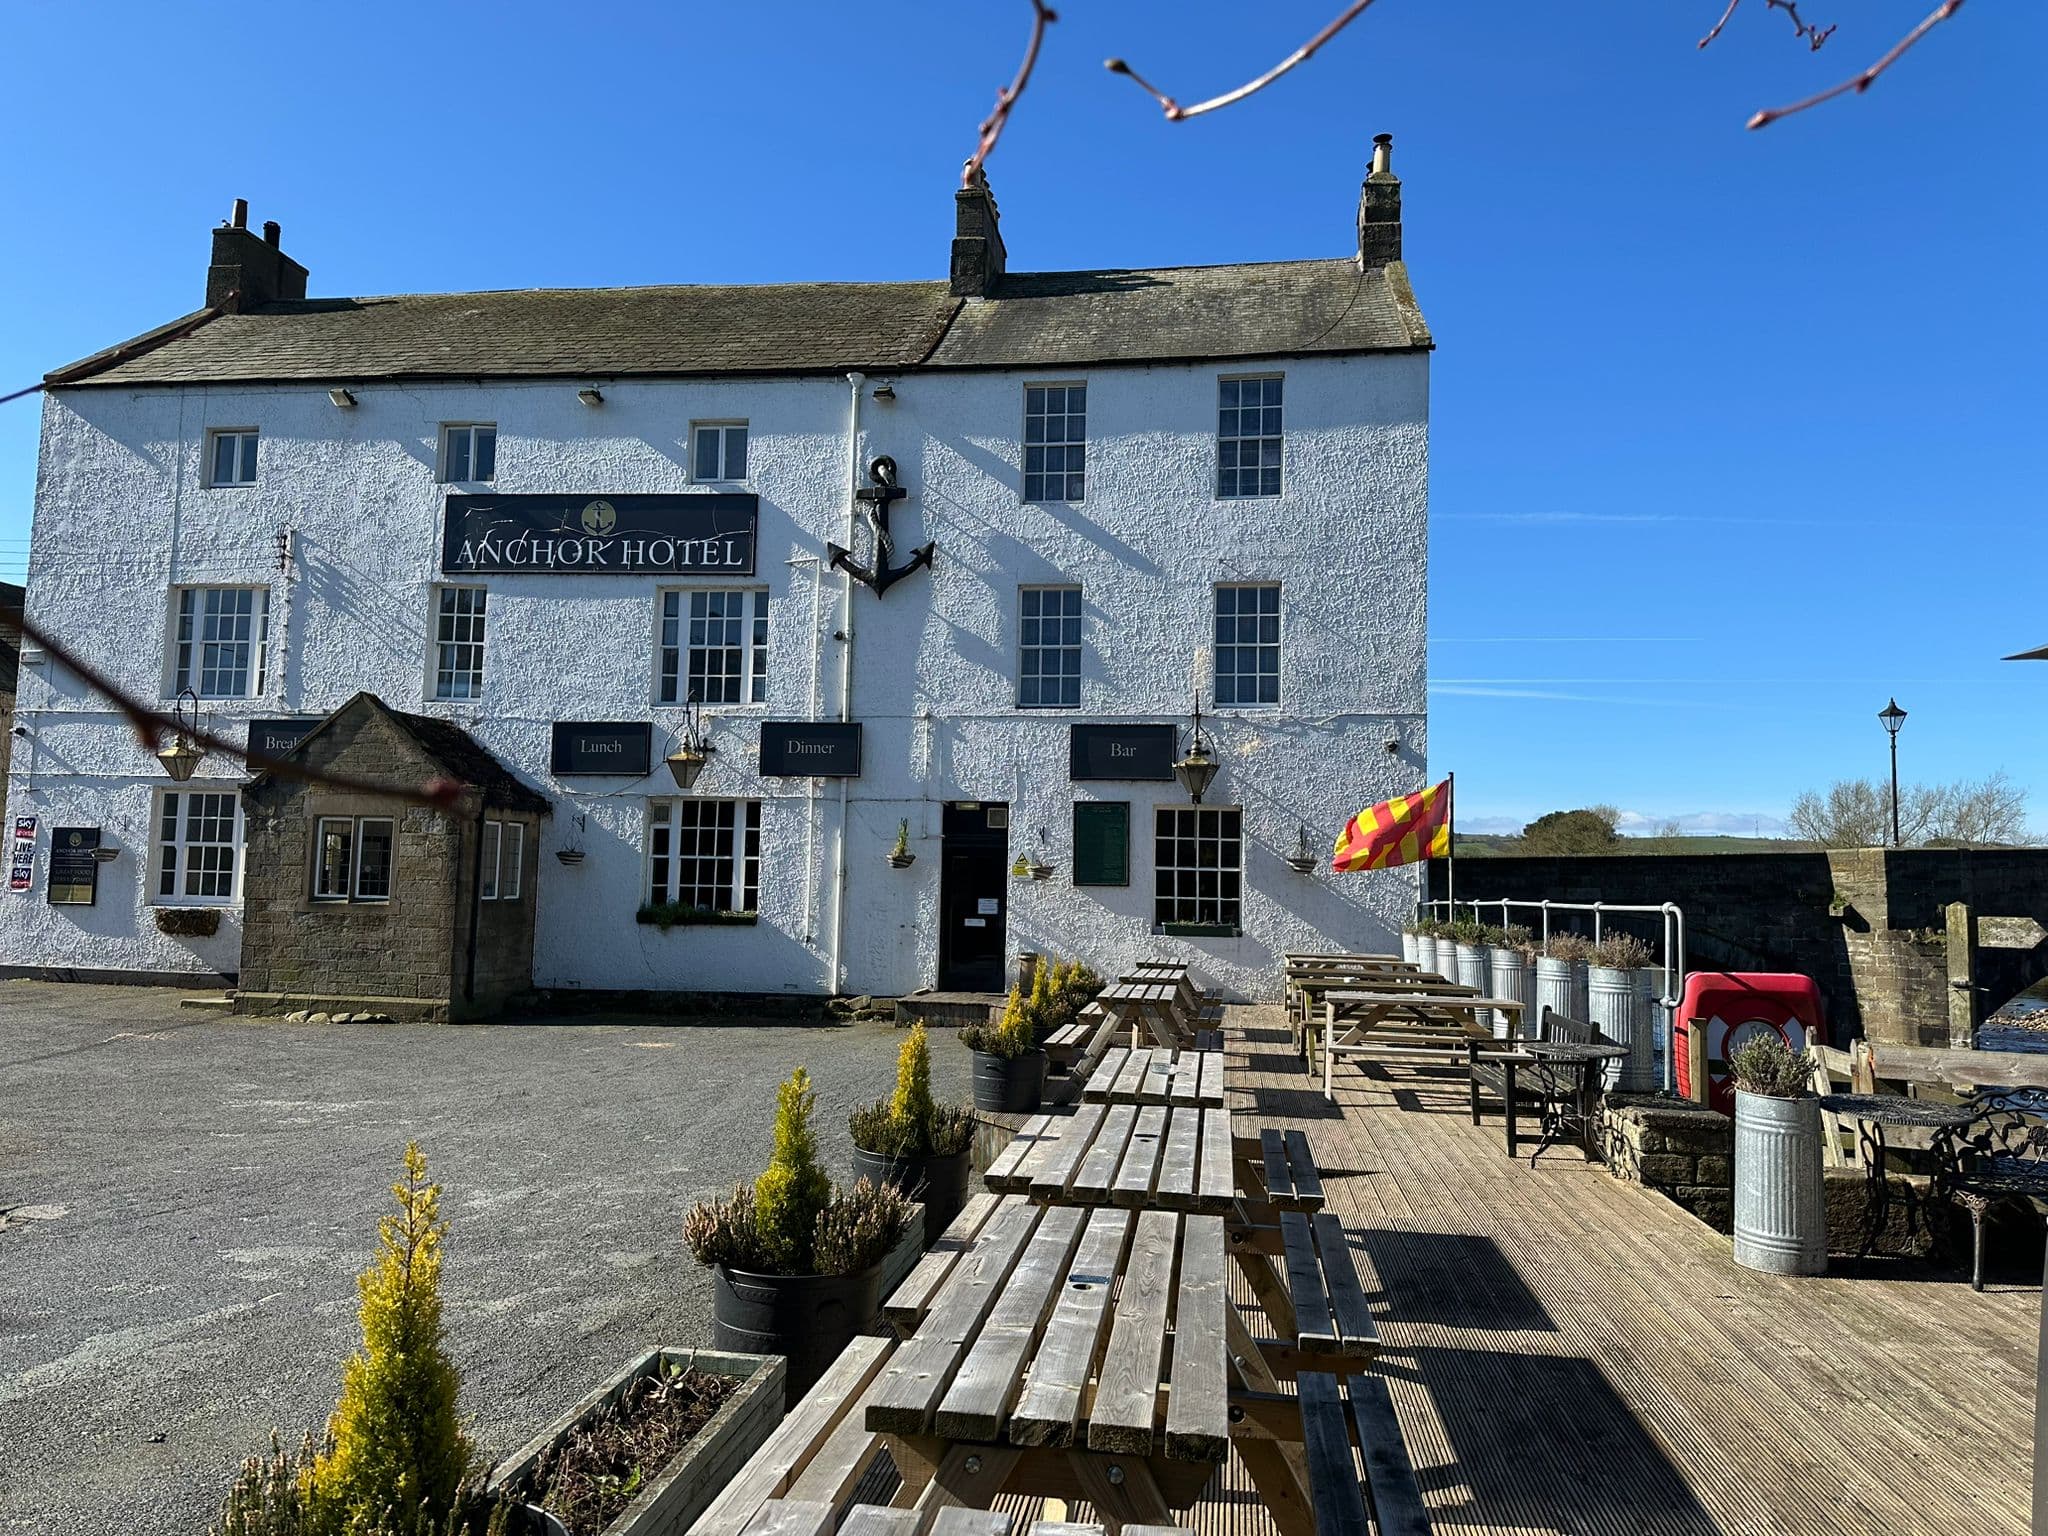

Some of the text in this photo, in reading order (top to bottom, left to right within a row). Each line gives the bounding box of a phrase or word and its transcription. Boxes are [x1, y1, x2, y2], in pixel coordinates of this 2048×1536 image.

[455, 537, 743, 567] ANCHOR HOTEL
[581, 739, 622, 753] Lunch
[787, 740, 835, 754] Dinner
[1110, 743, 1137, 757] Bar
[18, 819, 33, 829] sky
[15, 842, 33, 852] LIVE
[12, 853, 34, 864] HERE
[14, 869, 30, 879] sky
